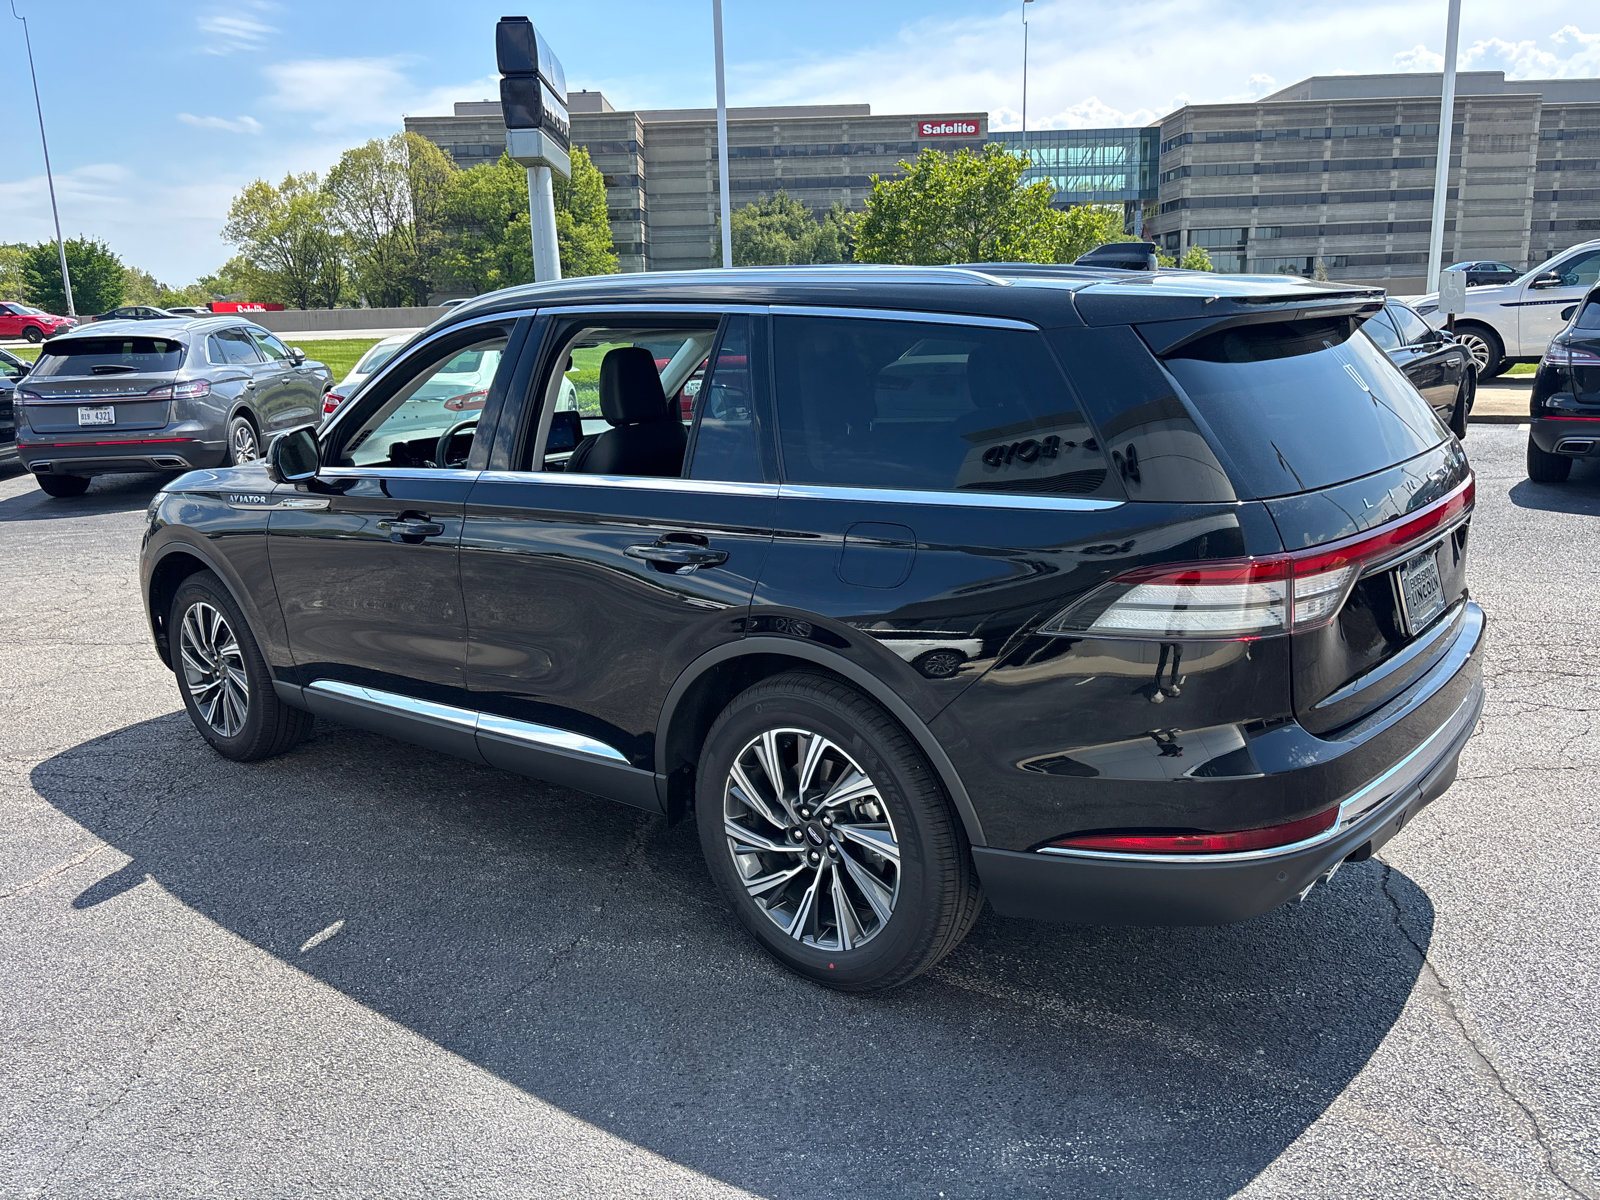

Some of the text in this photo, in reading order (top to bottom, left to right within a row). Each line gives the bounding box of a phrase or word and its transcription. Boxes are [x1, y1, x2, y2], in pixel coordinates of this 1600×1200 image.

[922, 122, 976, 134] Safelite
[95, 411, 111, 421] 4321
[229, 494, 266, 504] AVIATOR
[1410, 577, 1440, 607] LINCOLN
